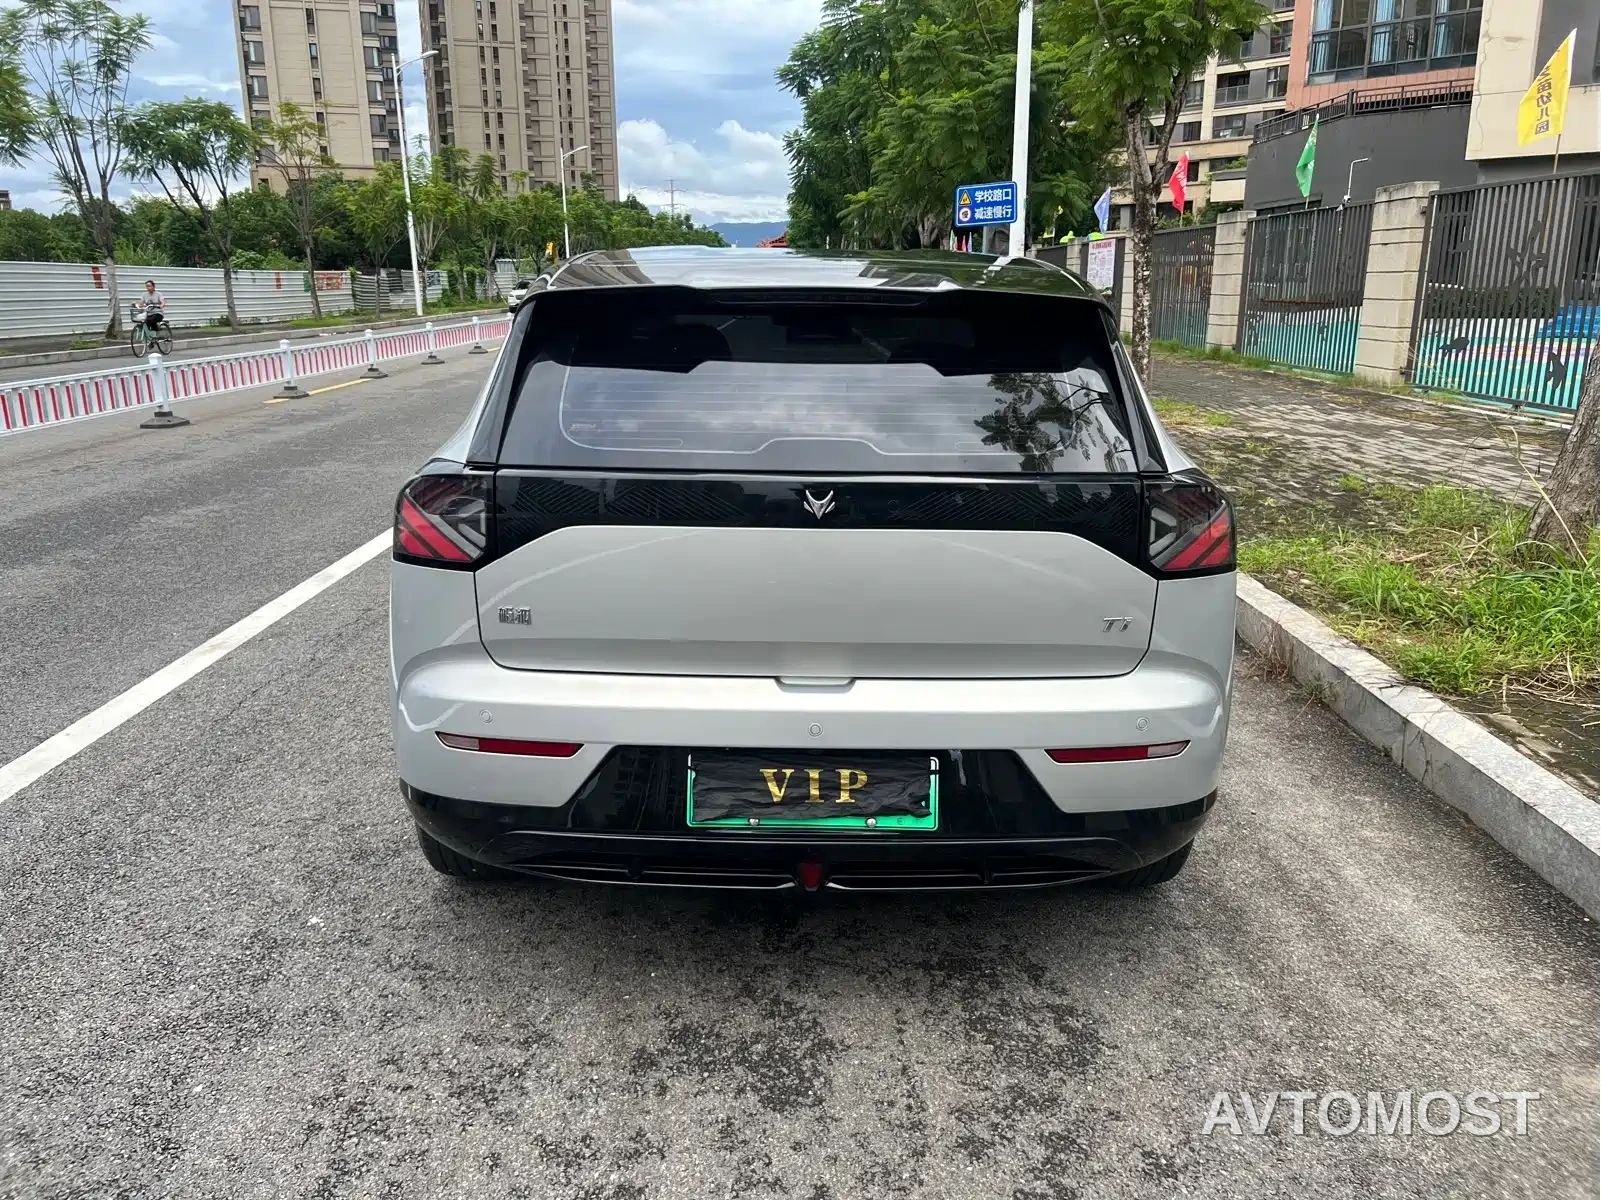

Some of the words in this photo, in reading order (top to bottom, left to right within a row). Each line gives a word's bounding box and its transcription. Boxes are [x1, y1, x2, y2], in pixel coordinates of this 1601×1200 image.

[974, 188, 1012, 203] 学校路口
[974, 205, 1012, 220] 减速慢行
[759, 768, 868, 804] VIP
